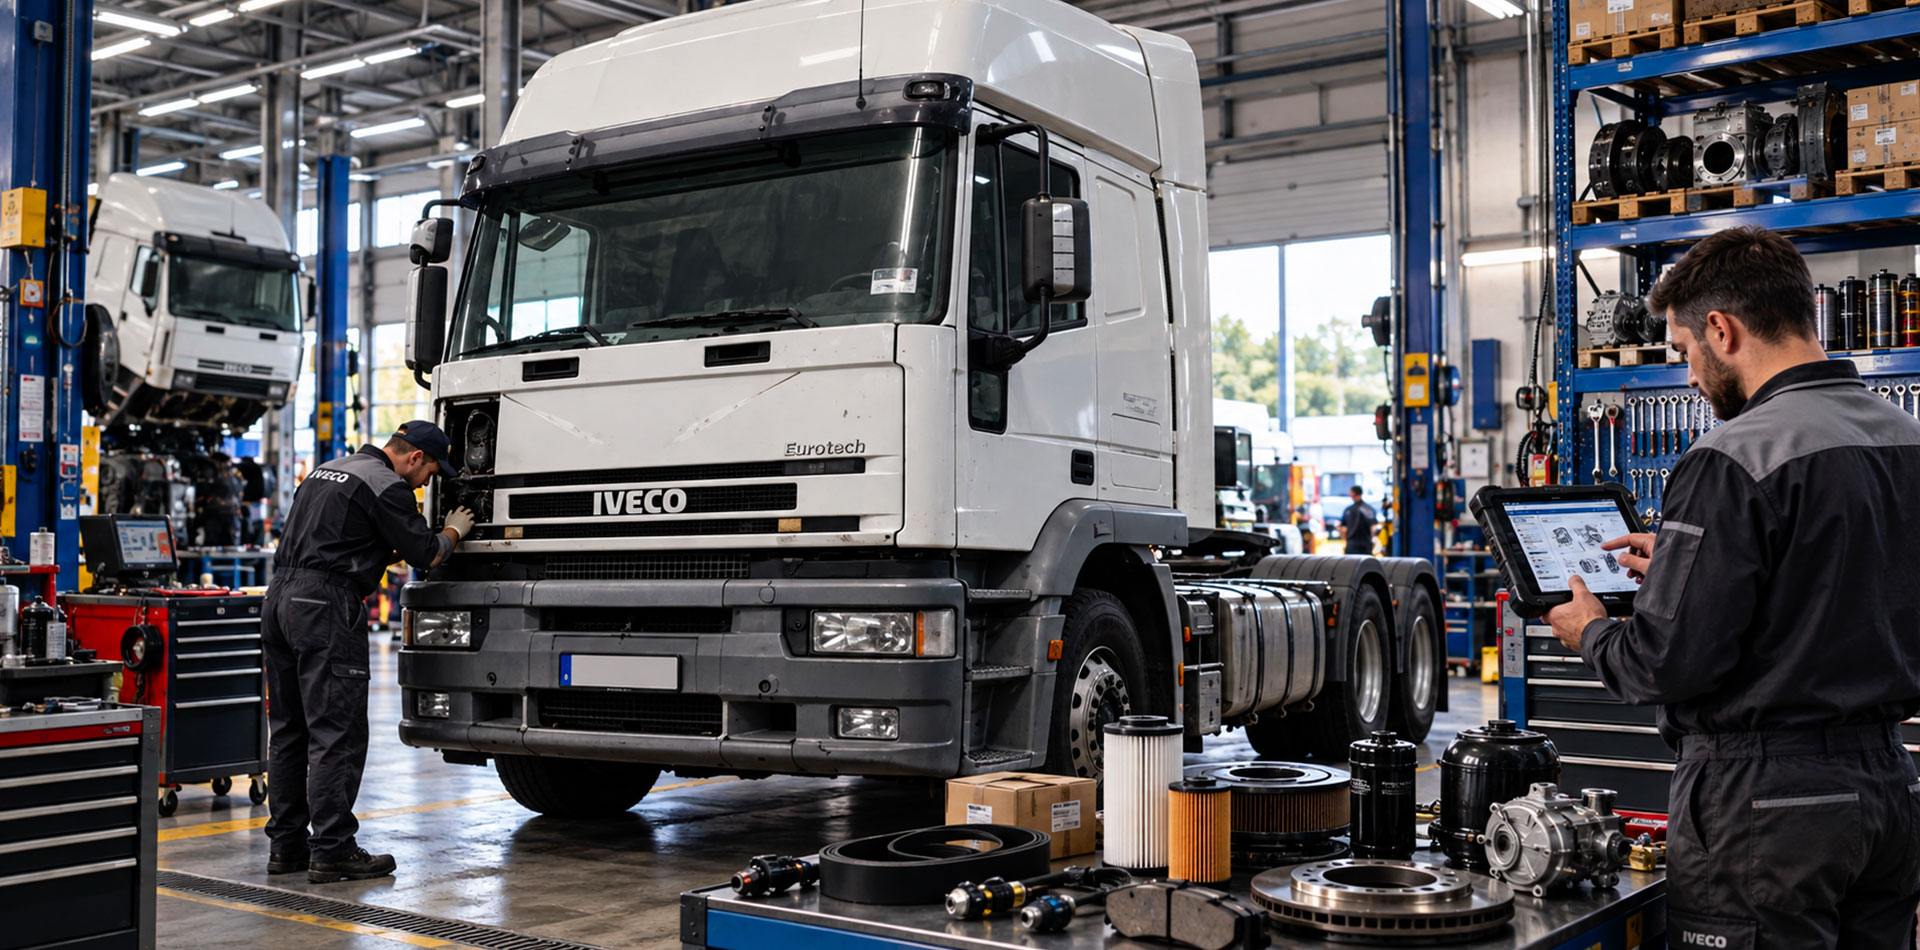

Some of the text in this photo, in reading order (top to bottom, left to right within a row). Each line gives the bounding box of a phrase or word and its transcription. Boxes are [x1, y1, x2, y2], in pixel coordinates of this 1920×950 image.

[785, 439, 866, 456] Eurotech
[309, 469, 349, 483] IVECO
[593, 488, 687, 515] IVECO
[1683, 930, 1727, 948] IVECO
